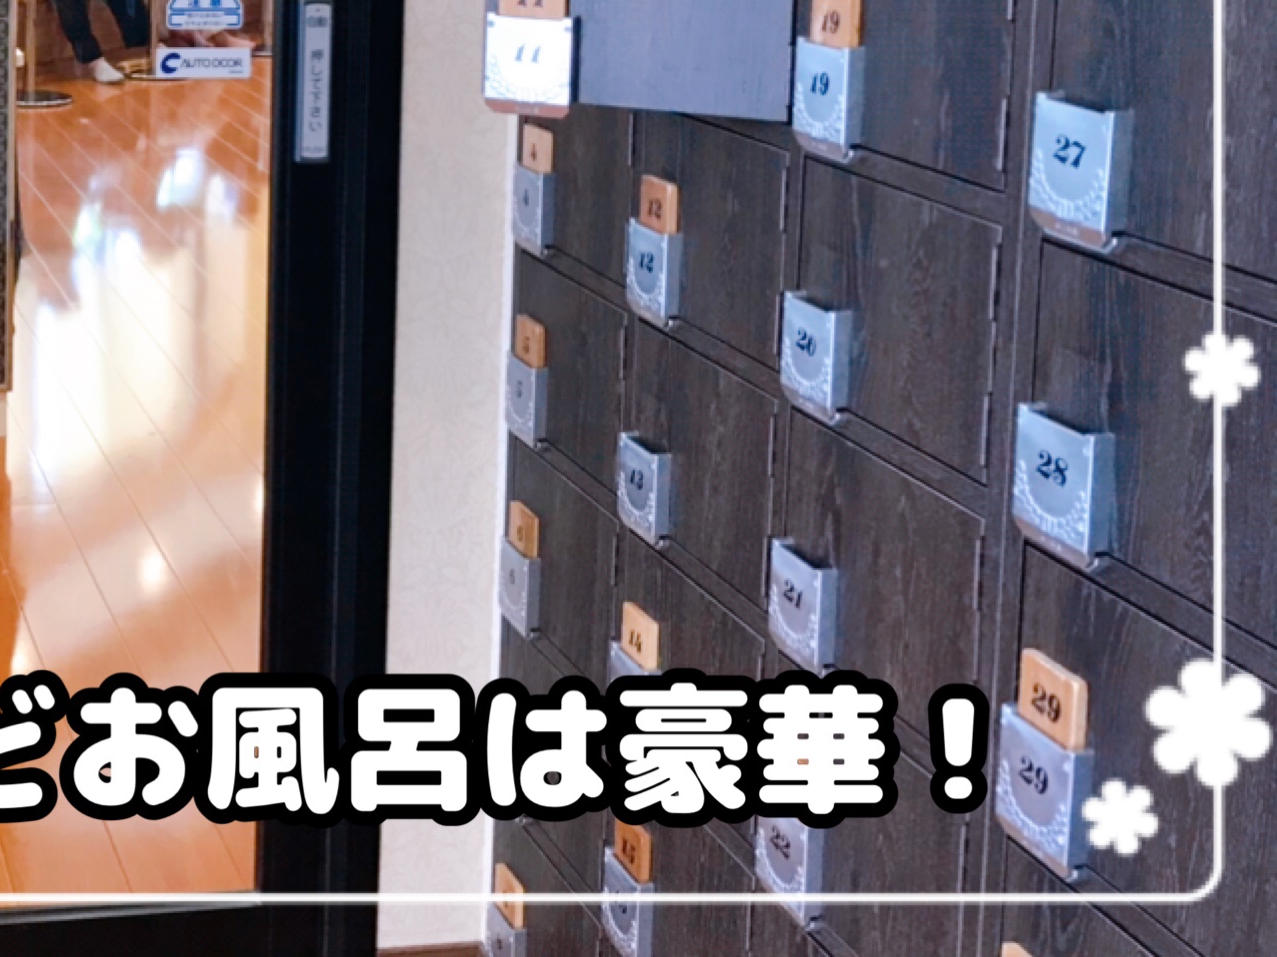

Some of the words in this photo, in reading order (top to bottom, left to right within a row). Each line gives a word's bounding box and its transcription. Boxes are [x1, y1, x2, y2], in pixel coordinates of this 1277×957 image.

[821, 9, 841, 34] 19
[179, 57, 211, 69] AUTO
[809, 71, 831, 96] 19
[1052, 133, 1087, 170] 27
[647, 197, 663, 221] 12
[638, 251, 654, 274] 12
[794, 327, 818, 358] 20
[630, 468, 644, 491] 13
[1035, 449, 1069, 488] 28
[782, 577, 803, 611] 21
[627, 628, 643, 655] 14
[1030, 681, 1061, 723] 29
[1018, 756, 1049, 795] 29
[621, 838, 637, 865] 15
[769, 825, 792, 861] 22
